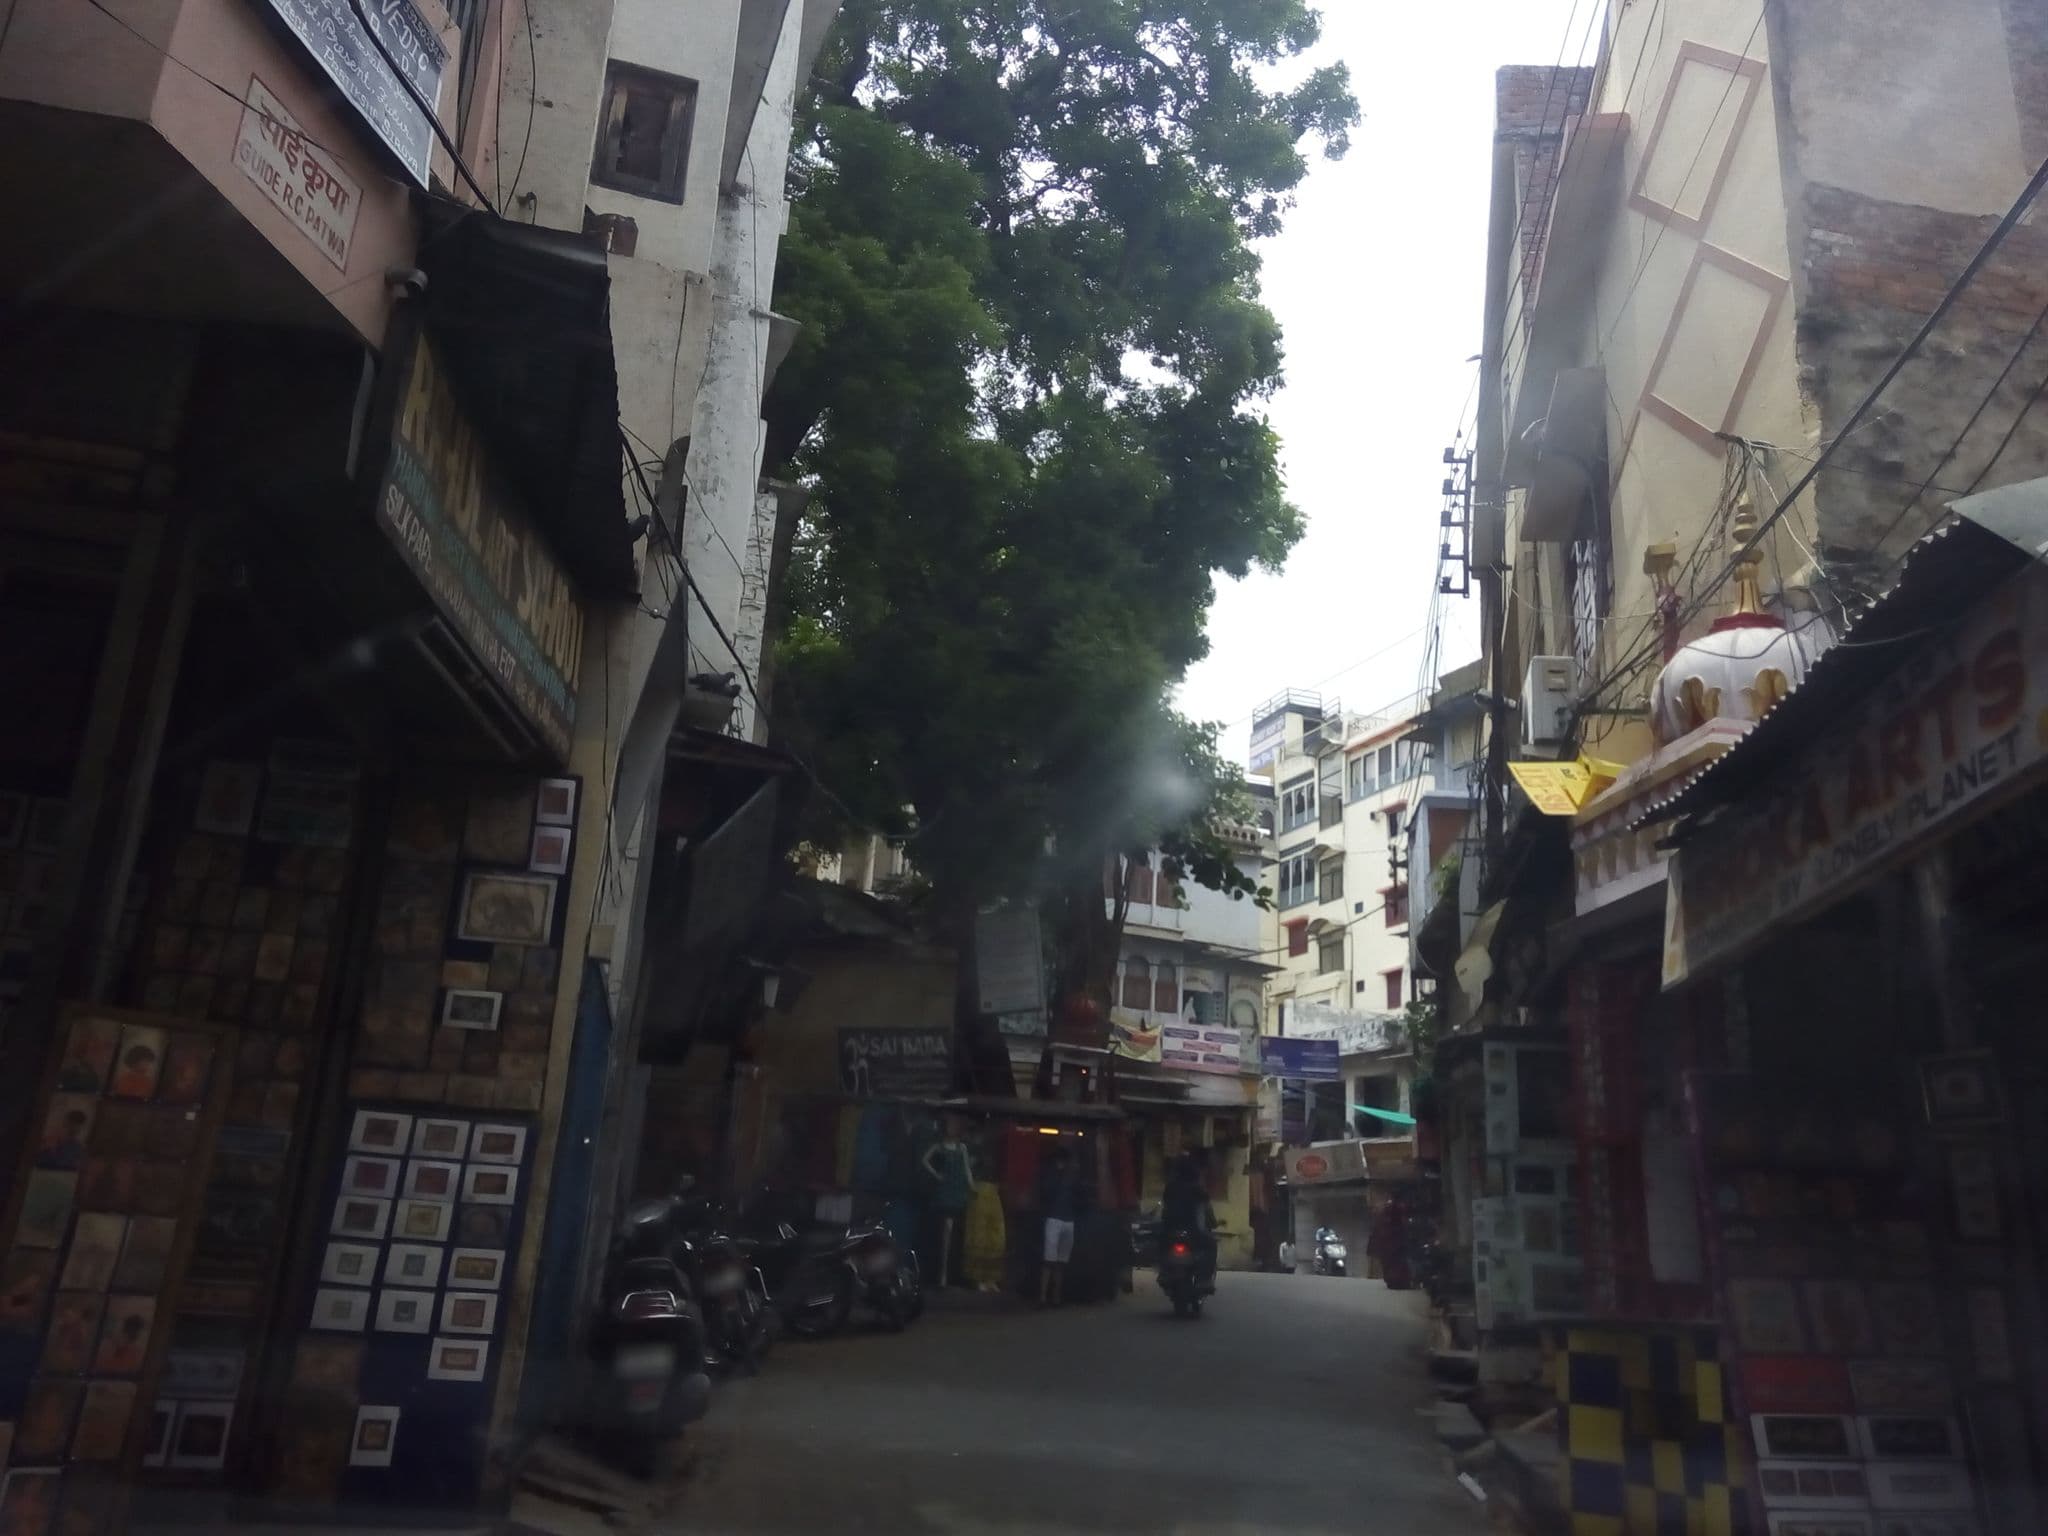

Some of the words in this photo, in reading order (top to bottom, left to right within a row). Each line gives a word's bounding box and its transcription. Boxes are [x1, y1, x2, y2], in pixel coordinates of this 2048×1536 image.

[382, 0, 429, 71] VEDIC
[239, 139, 282, 195] GUIDE
[305, 204, 346, 260] PATWA
[386, 483, 412, 539] SILK
[1847, 628, 2027, 820] ARTS
[1906, 724, 2022, 828] PLANET
